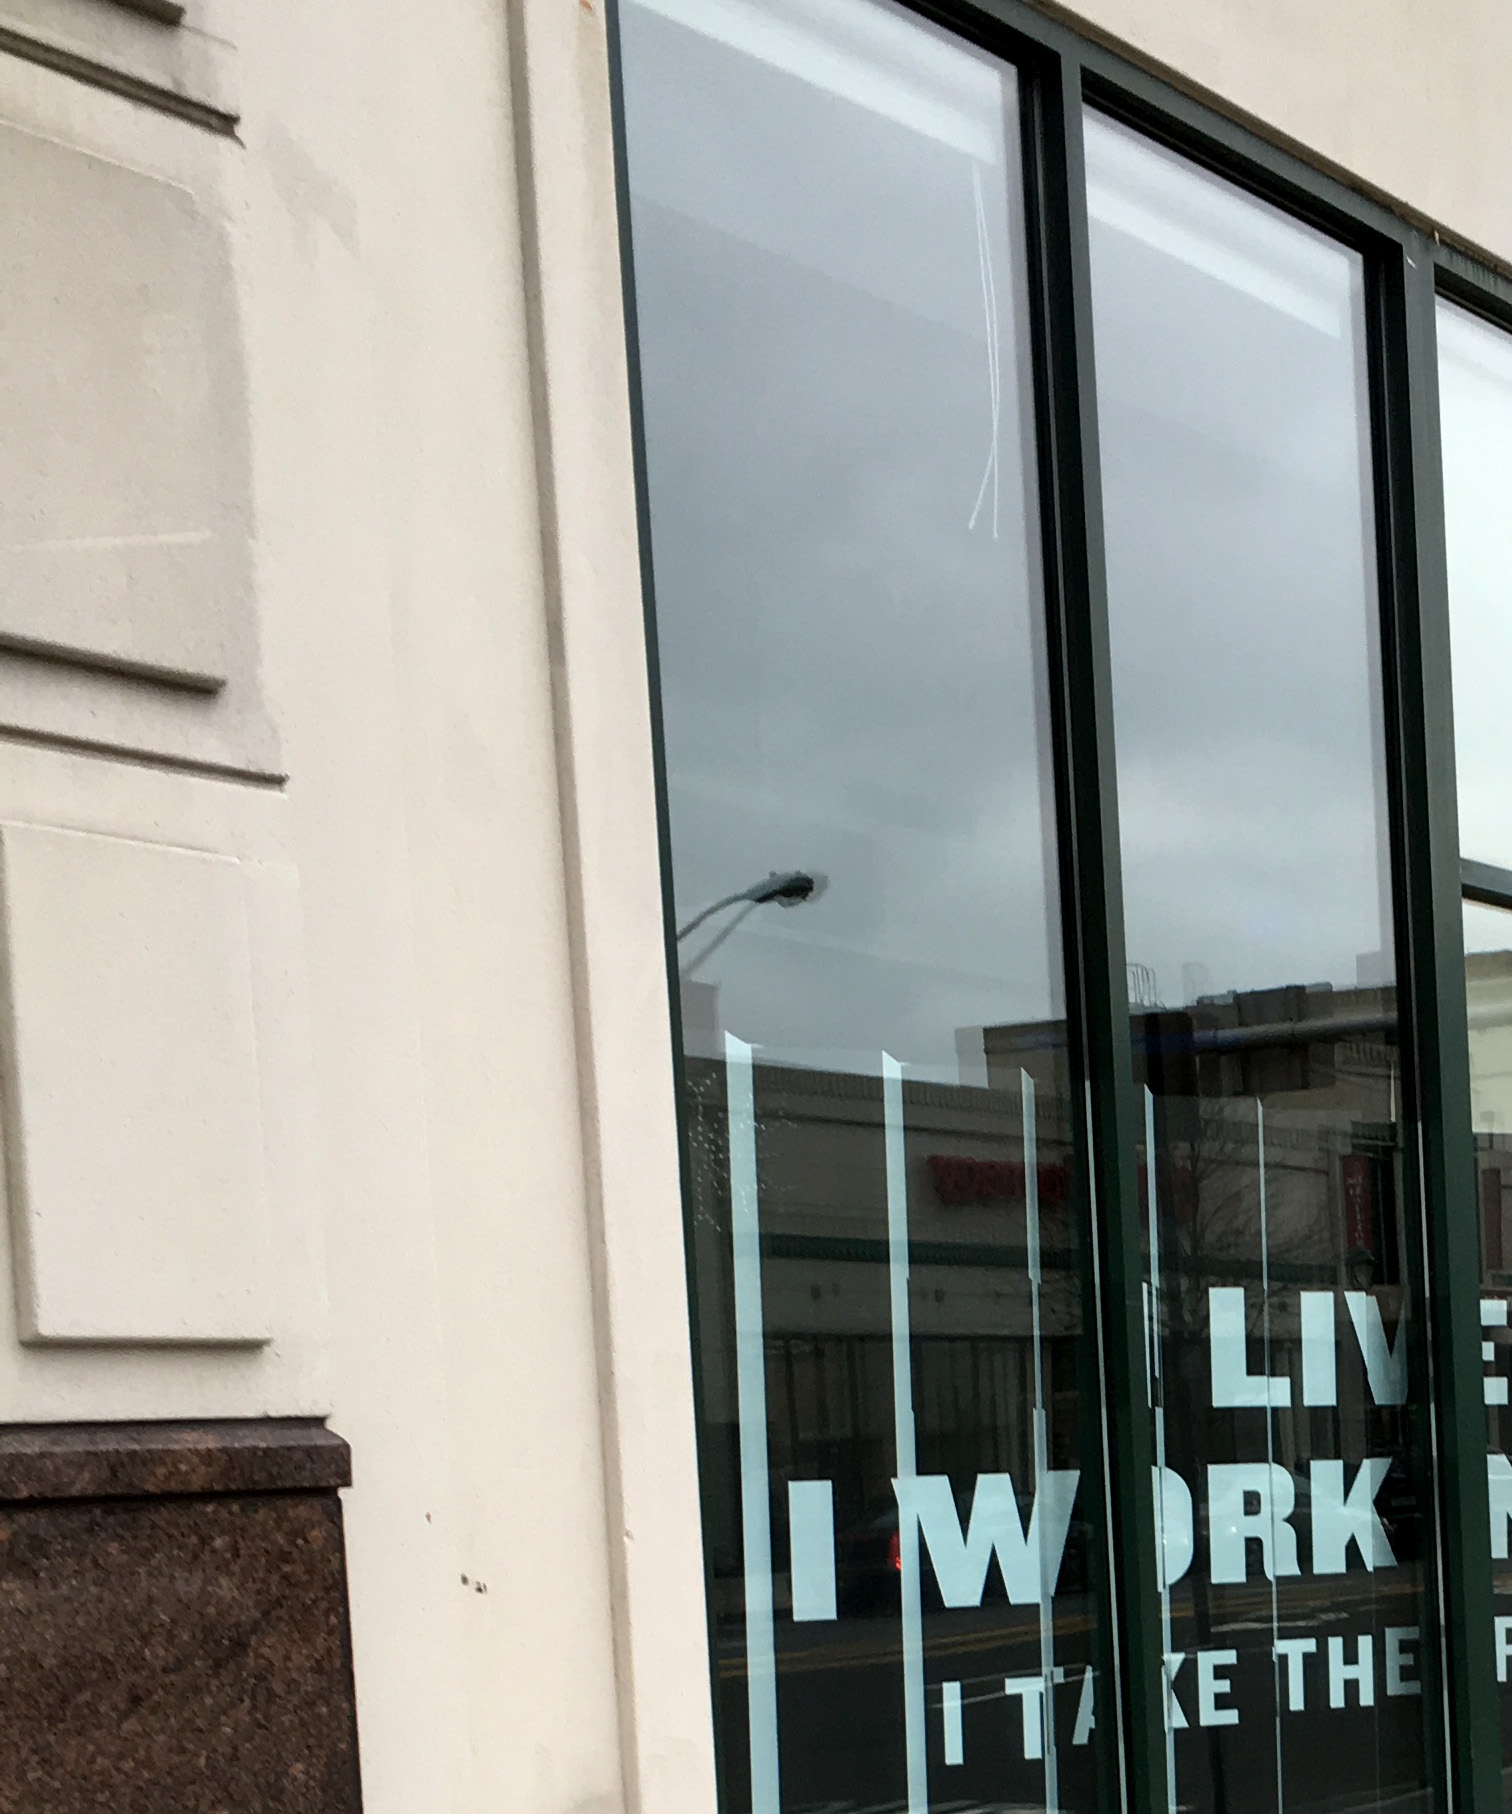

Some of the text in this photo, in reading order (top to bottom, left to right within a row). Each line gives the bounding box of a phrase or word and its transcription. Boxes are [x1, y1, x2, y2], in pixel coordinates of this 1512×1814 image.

[788, 1480, 838, 1622] I
[942, 1681, 964, 1766] I
[1273, 1626, 1422, 1711] THE
